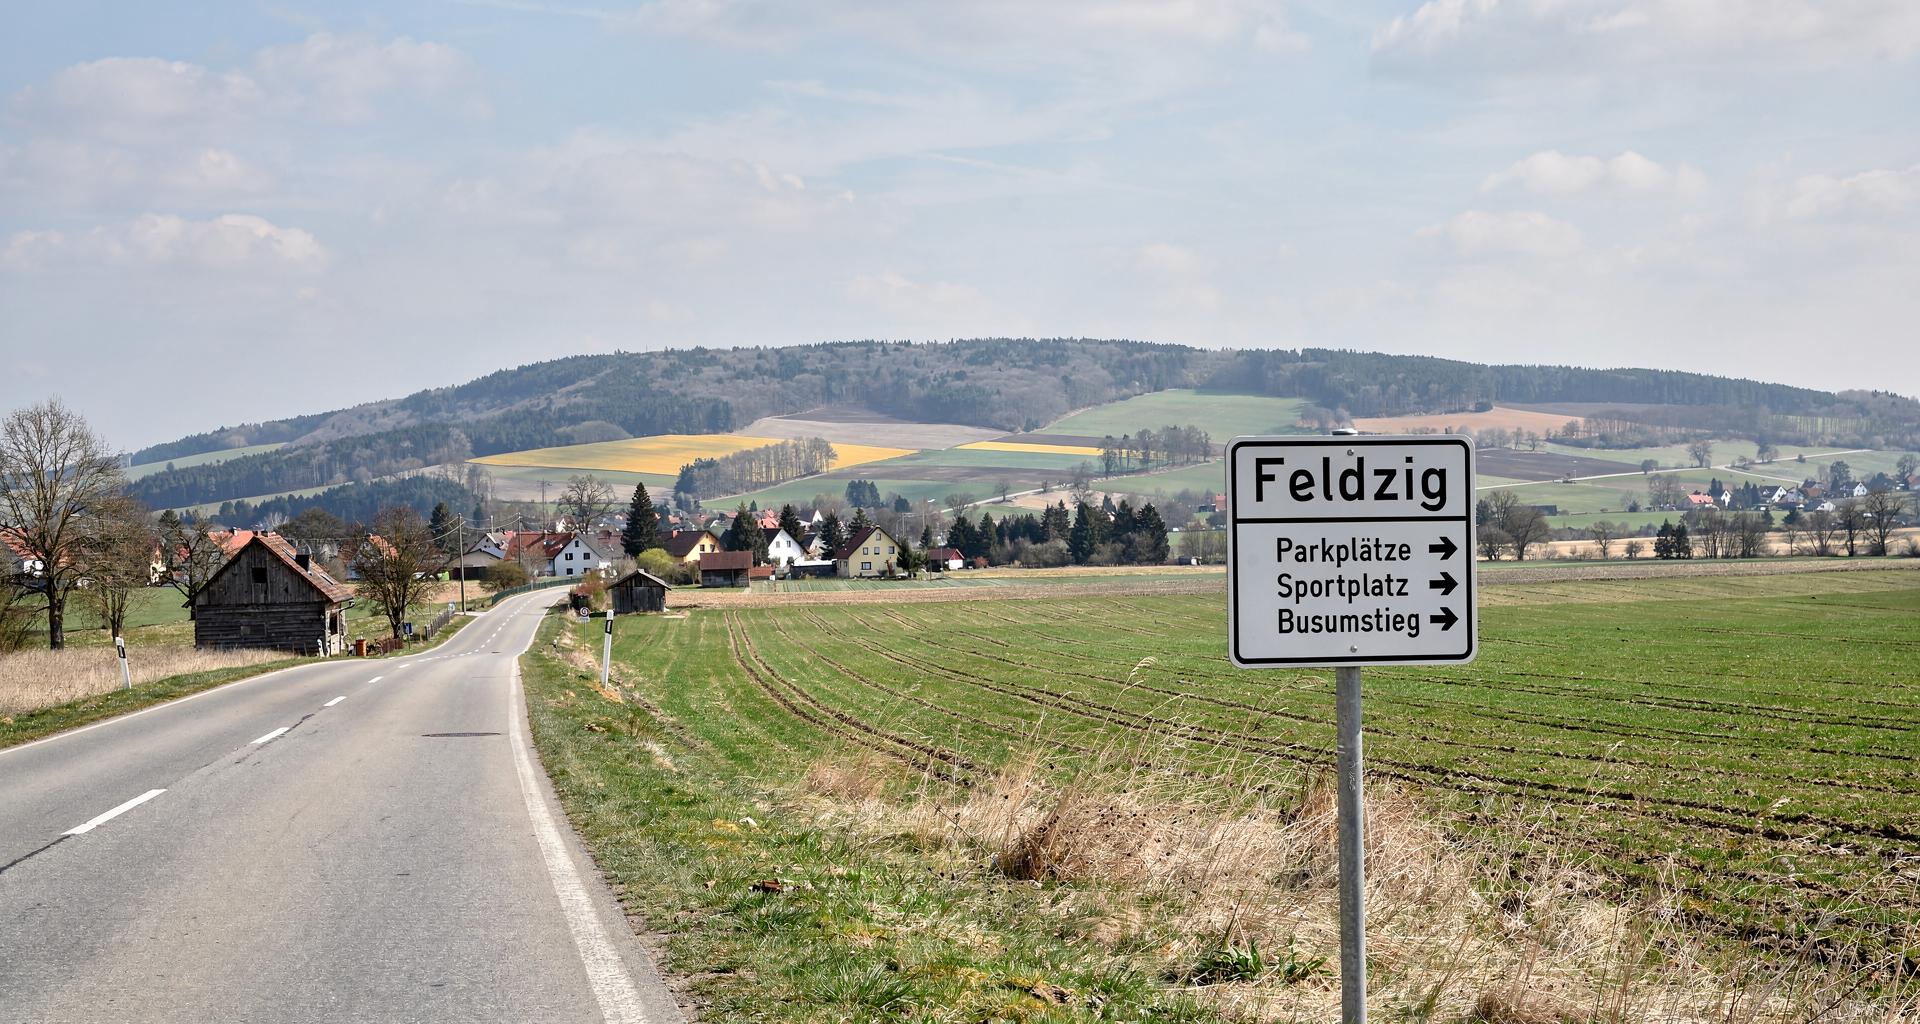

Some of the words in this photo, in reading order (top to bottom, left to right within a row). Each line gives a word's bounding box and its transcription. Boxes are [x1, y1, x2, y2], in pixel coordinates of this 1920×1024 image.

[1255, 456, 1447, 512] Feldzig
[1276, 537, 1412, 568] Parkplätze
[1277, 573, 1409, 604] Sportplatz
[1278, 607, 1420, 638] Busumstieg
